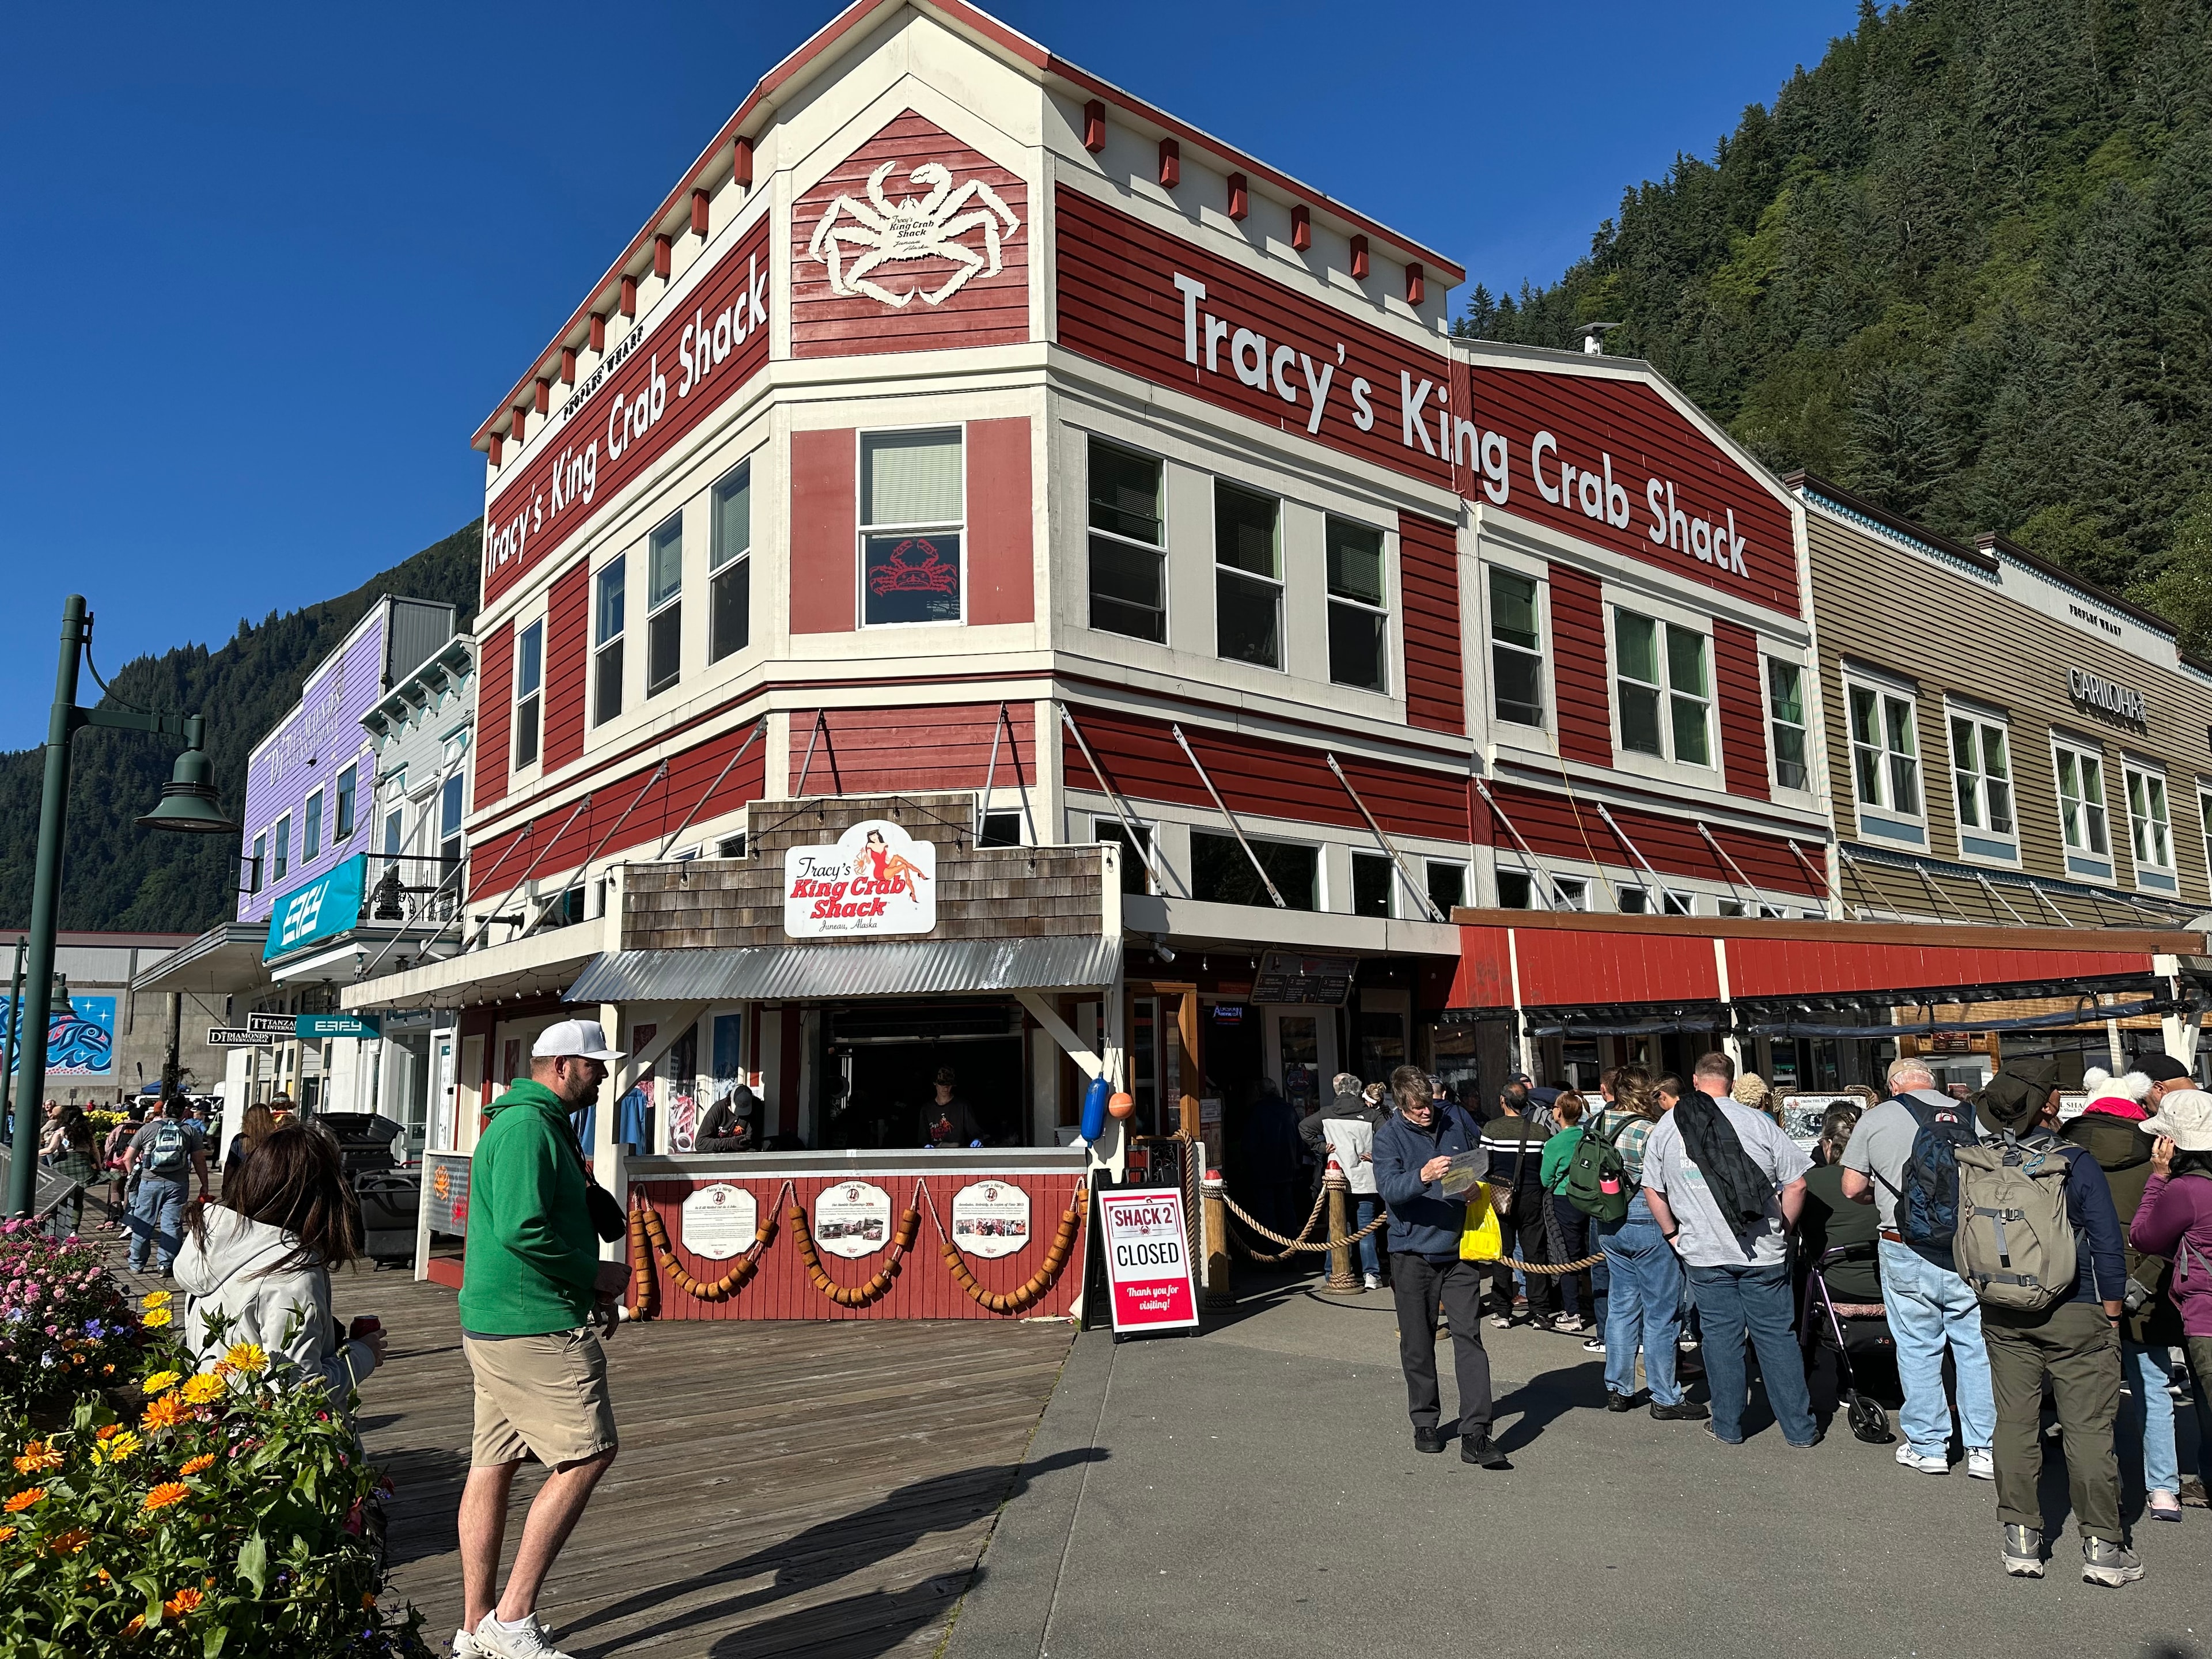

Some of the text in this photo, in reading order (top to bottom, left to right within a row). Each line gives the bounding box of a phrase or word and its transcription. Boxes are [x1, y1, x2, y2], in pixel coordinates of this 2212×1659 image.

[892, 215, 913, 224] Tracy's
[912, 220, 934, 229] Crab
[897, 229, 927, 238] Shack
[563, 325, 643, 421] PEOPLES' WHARF
[488, 252, 768, 578] Tracy's King Crab Shack
[1173, 271, 1750, 578] Tracy's King Crab Shack
[2099, 618, 2122, 637] WHARF
[2067, 667, 2142, 722] CARILOHA
[286, 685, 340, 757] DIAMONDS
[285, 713, 339, 774] INTERNATIONAL
[797, 857, 851, 881] Tracy's
[790, 875, 906, 900] King Crab
[810, 897, 888, 919] Shack
[819, 918, 877, 932] Juneau, Alaska
[1115, 1207, 1172, 1227] SHACK 2
[1117, 1243, 1179, 1266] CLOSED
[1127, 1285, 1179, 1298] Thank you for
[1139, 1299, 1171, 1311] visiting!
